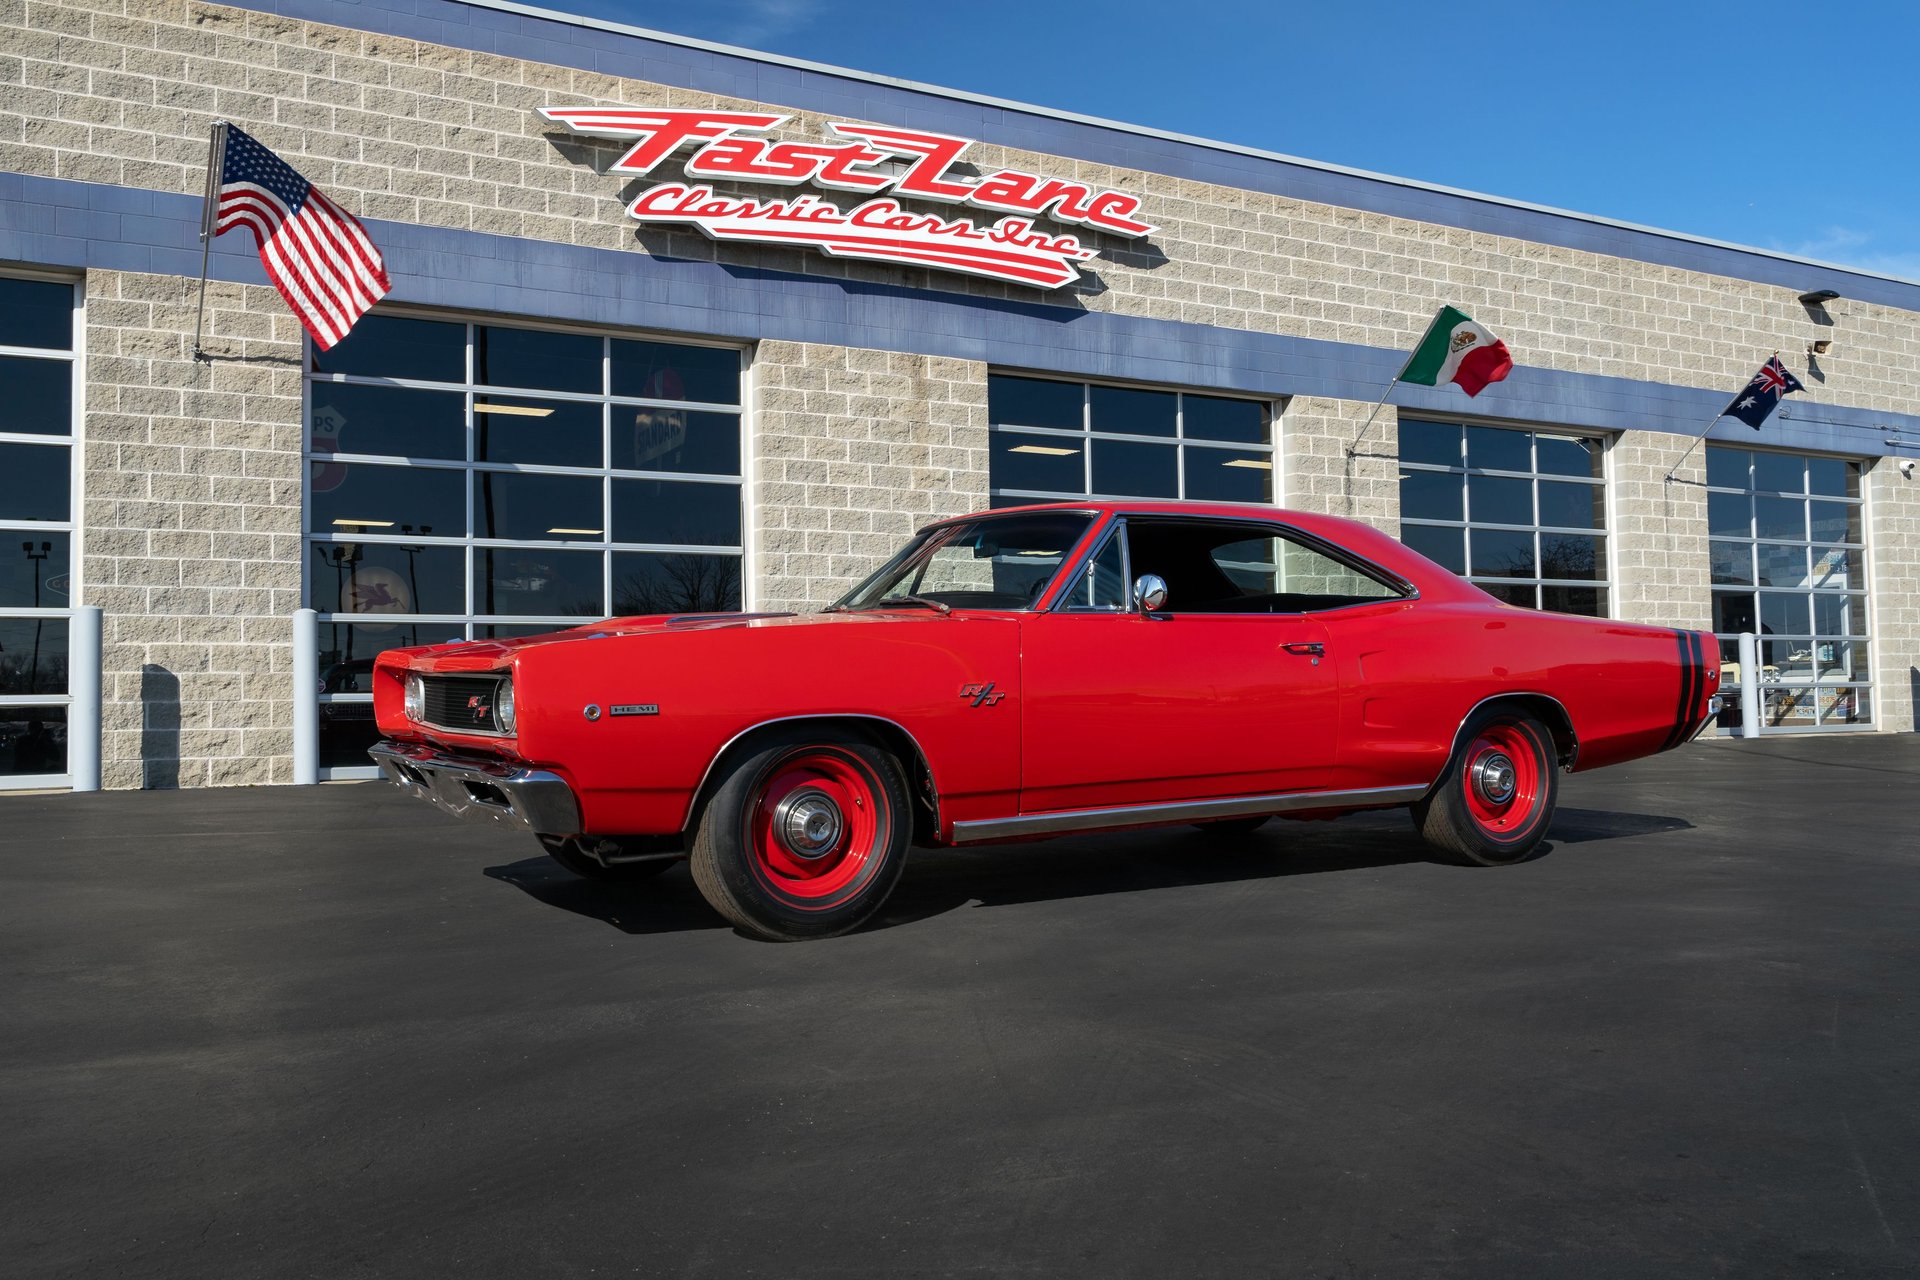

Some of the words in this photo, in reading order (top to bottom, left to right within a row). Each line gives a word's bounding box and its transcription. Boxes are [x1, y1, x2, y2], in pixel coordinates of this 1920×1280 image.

[546, 109, 890, 187] Fast
[835, 125, 1151, 234] Lane
[634, 187, 847, 225] Classic
[850, 202, 986, 240] Cars
[988, 220, 1093, 258] Inc.
[960, 681, 1005, 707] R/T
[467, 695, 490, 721] R/T
[613, 705, 656, 713] HEMI
